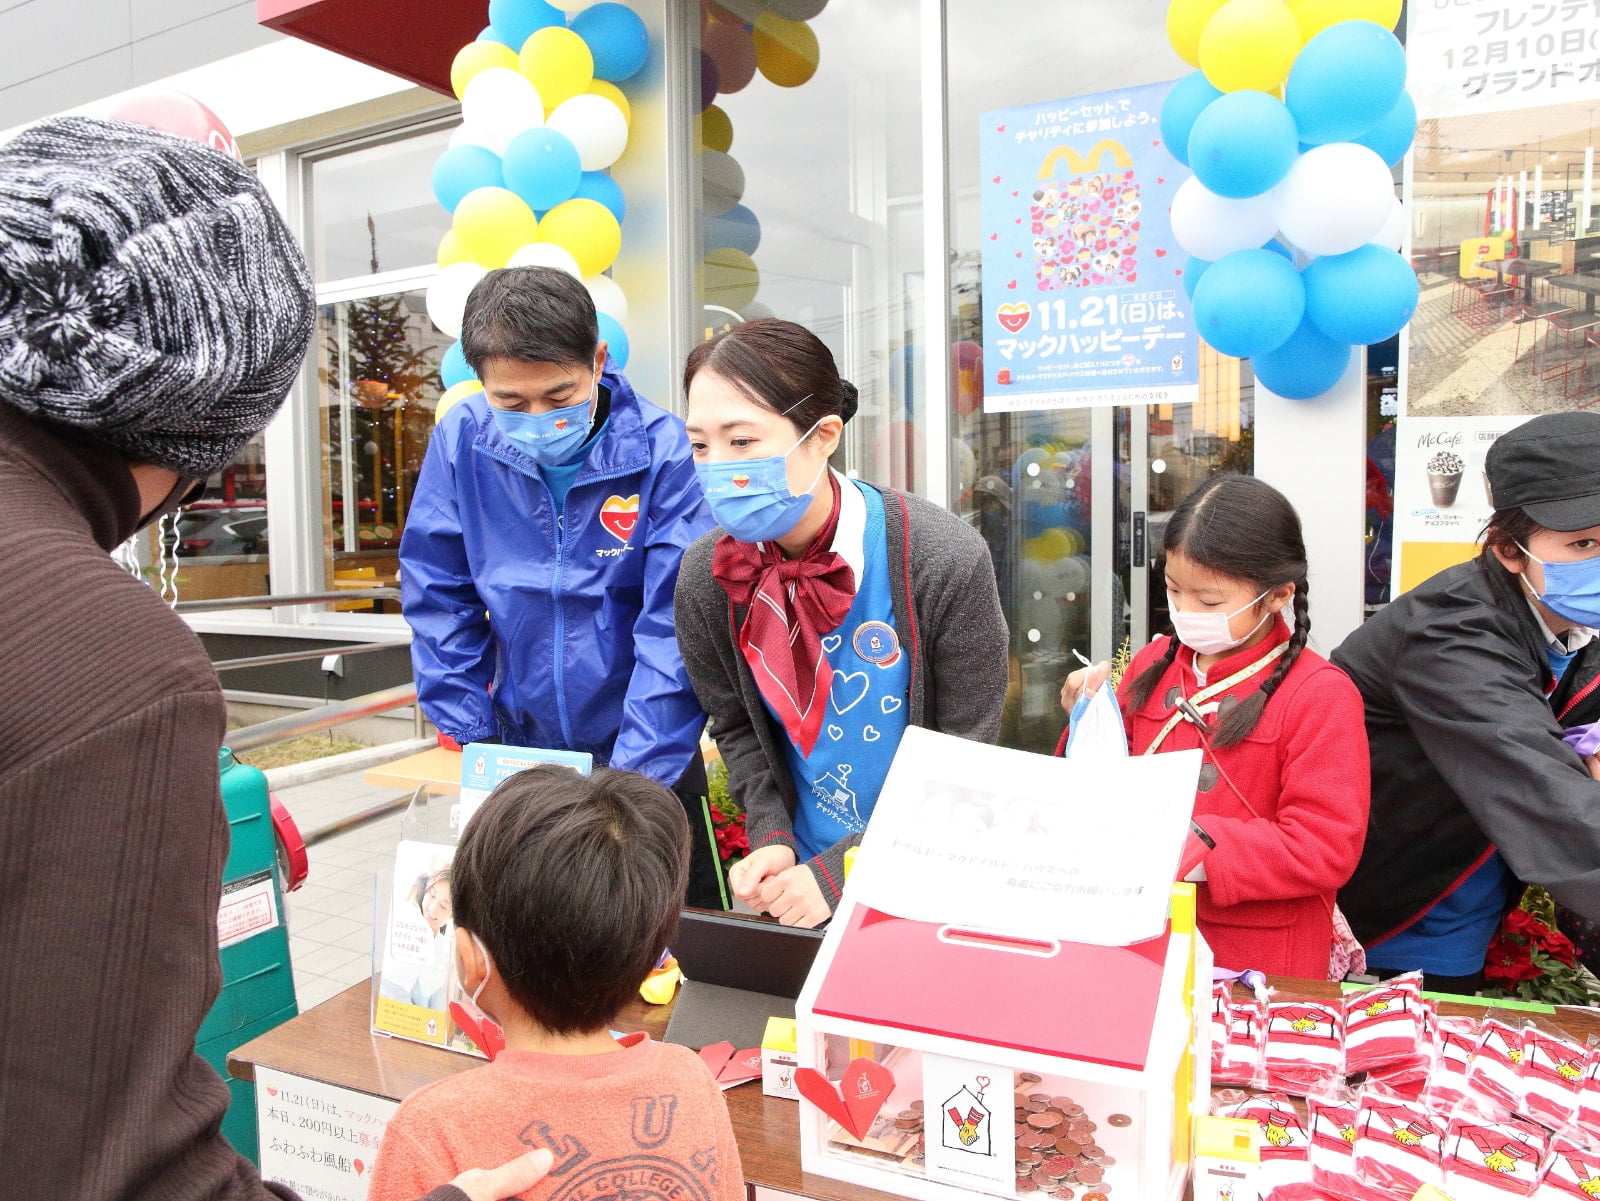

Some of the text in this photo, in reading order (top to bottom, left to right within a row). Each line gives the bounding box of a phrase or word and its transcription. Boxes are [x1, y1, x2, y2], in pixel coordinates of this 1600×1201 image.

[1442, 27, 1600, 70] 12月10日(
[1014, 110, 1158, 144] チャリティに参加しよう。
[995, 324, 1186, 361] マックハッピーデー
[1417, 431, 1463, 449] McCafé
[269, 1137, 353, 1173] ふわふわ風船
[595, 1171, 684, 1200] COLLEGE
